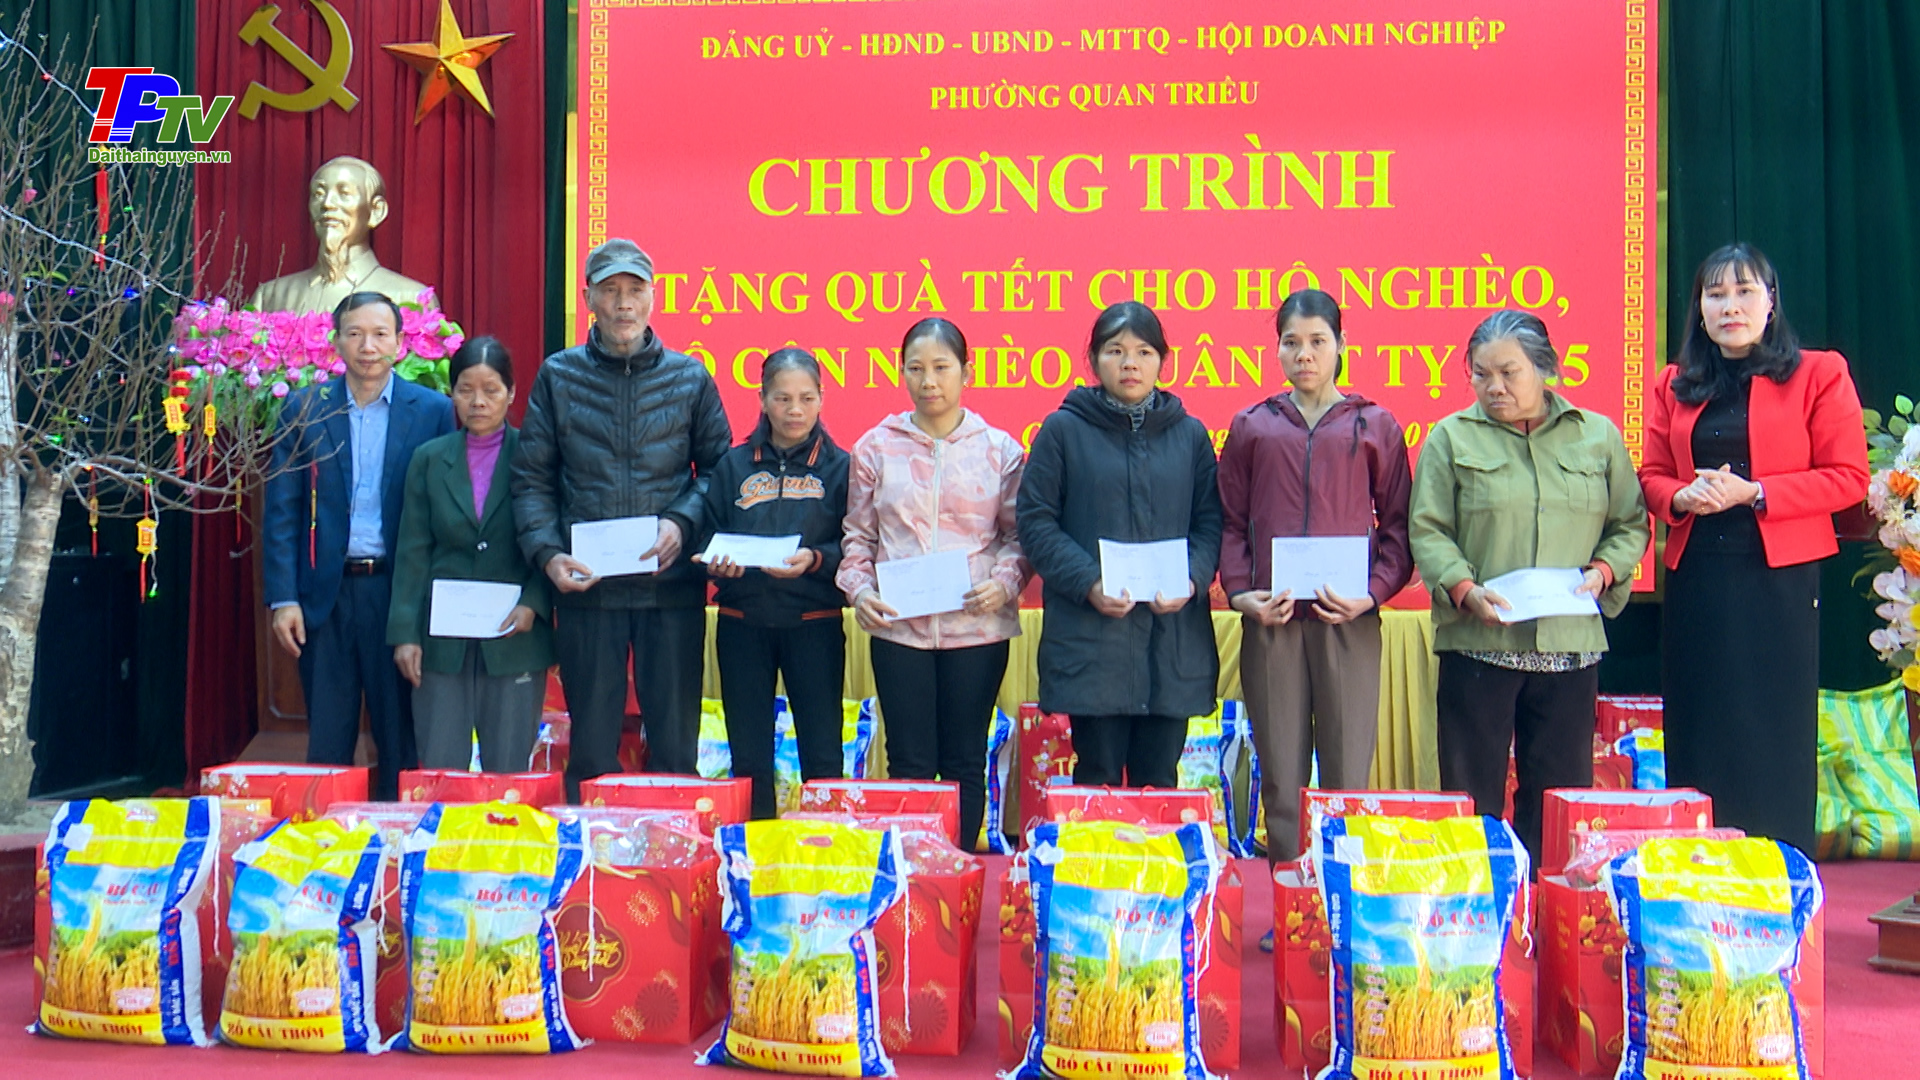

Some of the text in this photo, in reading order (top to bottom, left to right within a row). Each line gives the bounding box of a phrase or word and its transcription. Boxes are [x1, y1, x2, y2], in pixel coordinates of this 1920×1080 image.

[701, 29, 785, 59] ĐẢNG
[860, 32, 945, 56] HĐND
[971, 30, 1054, 54] UBND
[1080, 27, 1171, 55] MTTQ
[1196, 22, 1252, 55] HỘI
[1263, 23, 1374, 48] DOANH
[1384, 16, 1506, 50] NGHIỆP
[930, 79, 1060, 110] PHƯỜNG
[1068, 83, 1156, 112] QUAN
[748, 133, 1396, 217] CHƯƠNG TRÌNH
[653, 266, 810, 325] TẶNG
[825, 258, 947, 323] QUÀ
[962, 257, 1073, 312] TẾT
[1088, 268, 1217, 311] CHO
[1337, 253, 1570, 318] NGHÈO,
[1376, 344, 1456, 399] TỴ
